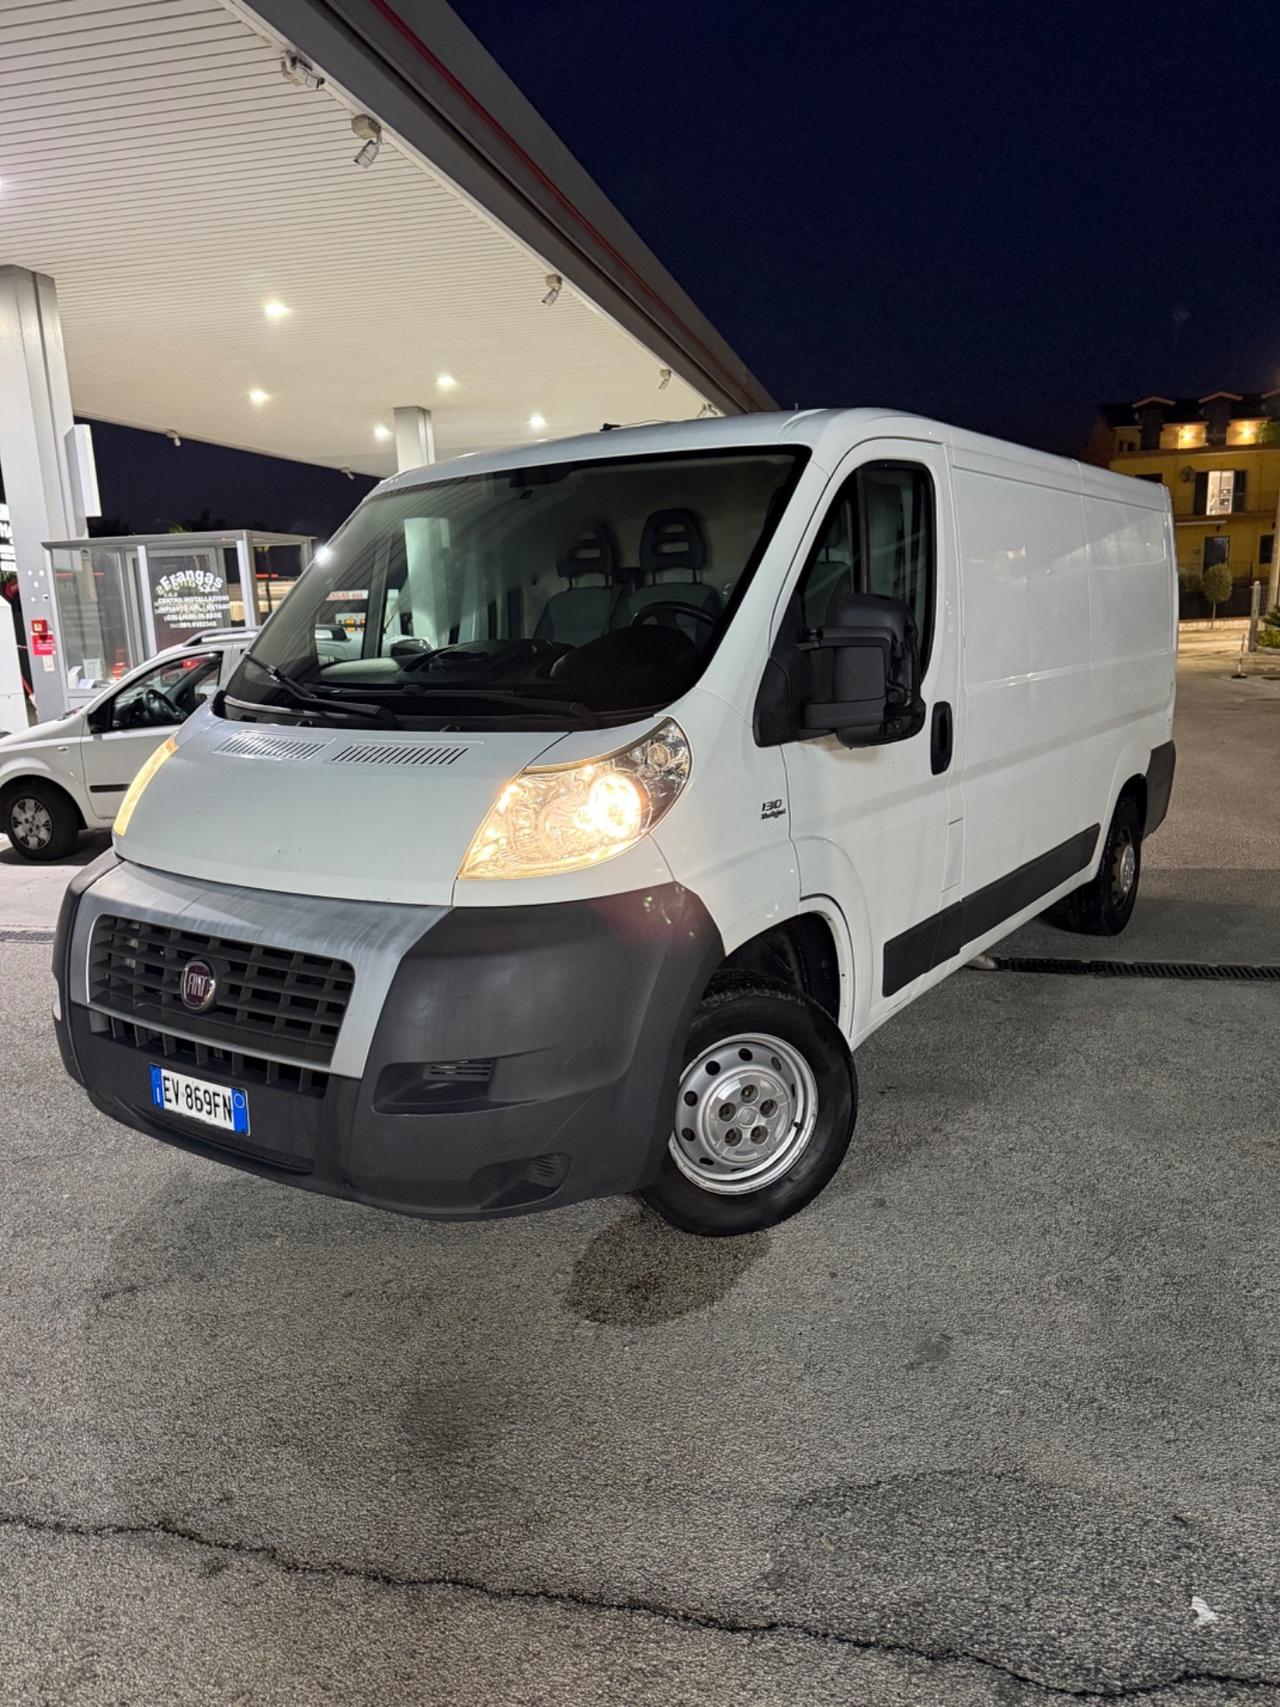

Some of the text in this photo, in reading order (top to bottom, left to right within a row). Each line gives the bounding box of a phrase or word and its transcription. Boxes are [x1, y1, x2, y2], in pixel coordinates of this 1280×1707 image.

[761, 799, 782, 812] 130
[187, 973, 208, 997] FIAT
[163, 1076, 179, 1105] EV
[184, 1084, 232, 1122] 869FN
